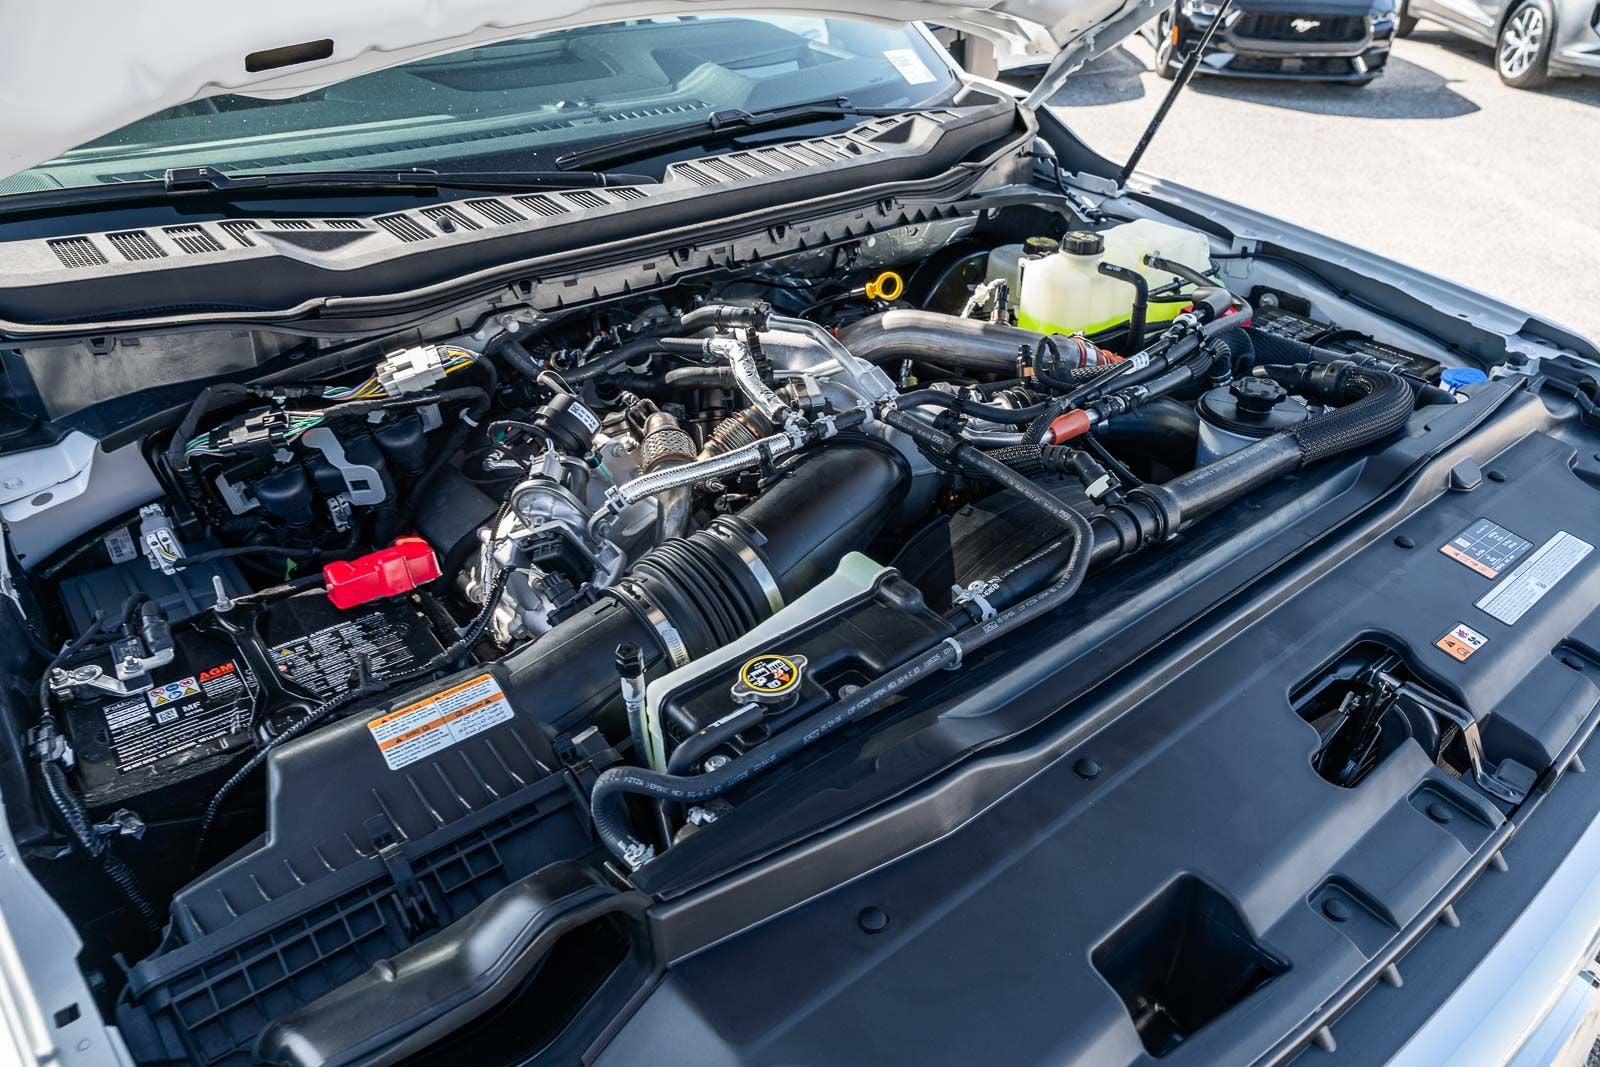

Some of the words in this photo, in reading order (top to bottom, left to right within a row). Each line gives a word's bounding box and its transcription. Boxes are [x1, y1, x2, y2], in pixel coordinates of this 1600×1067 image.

[199, 662, 234, 681] AGM
[104, 695, 145, 714] FoMoCo
[182, 702, 200, 713] MF
